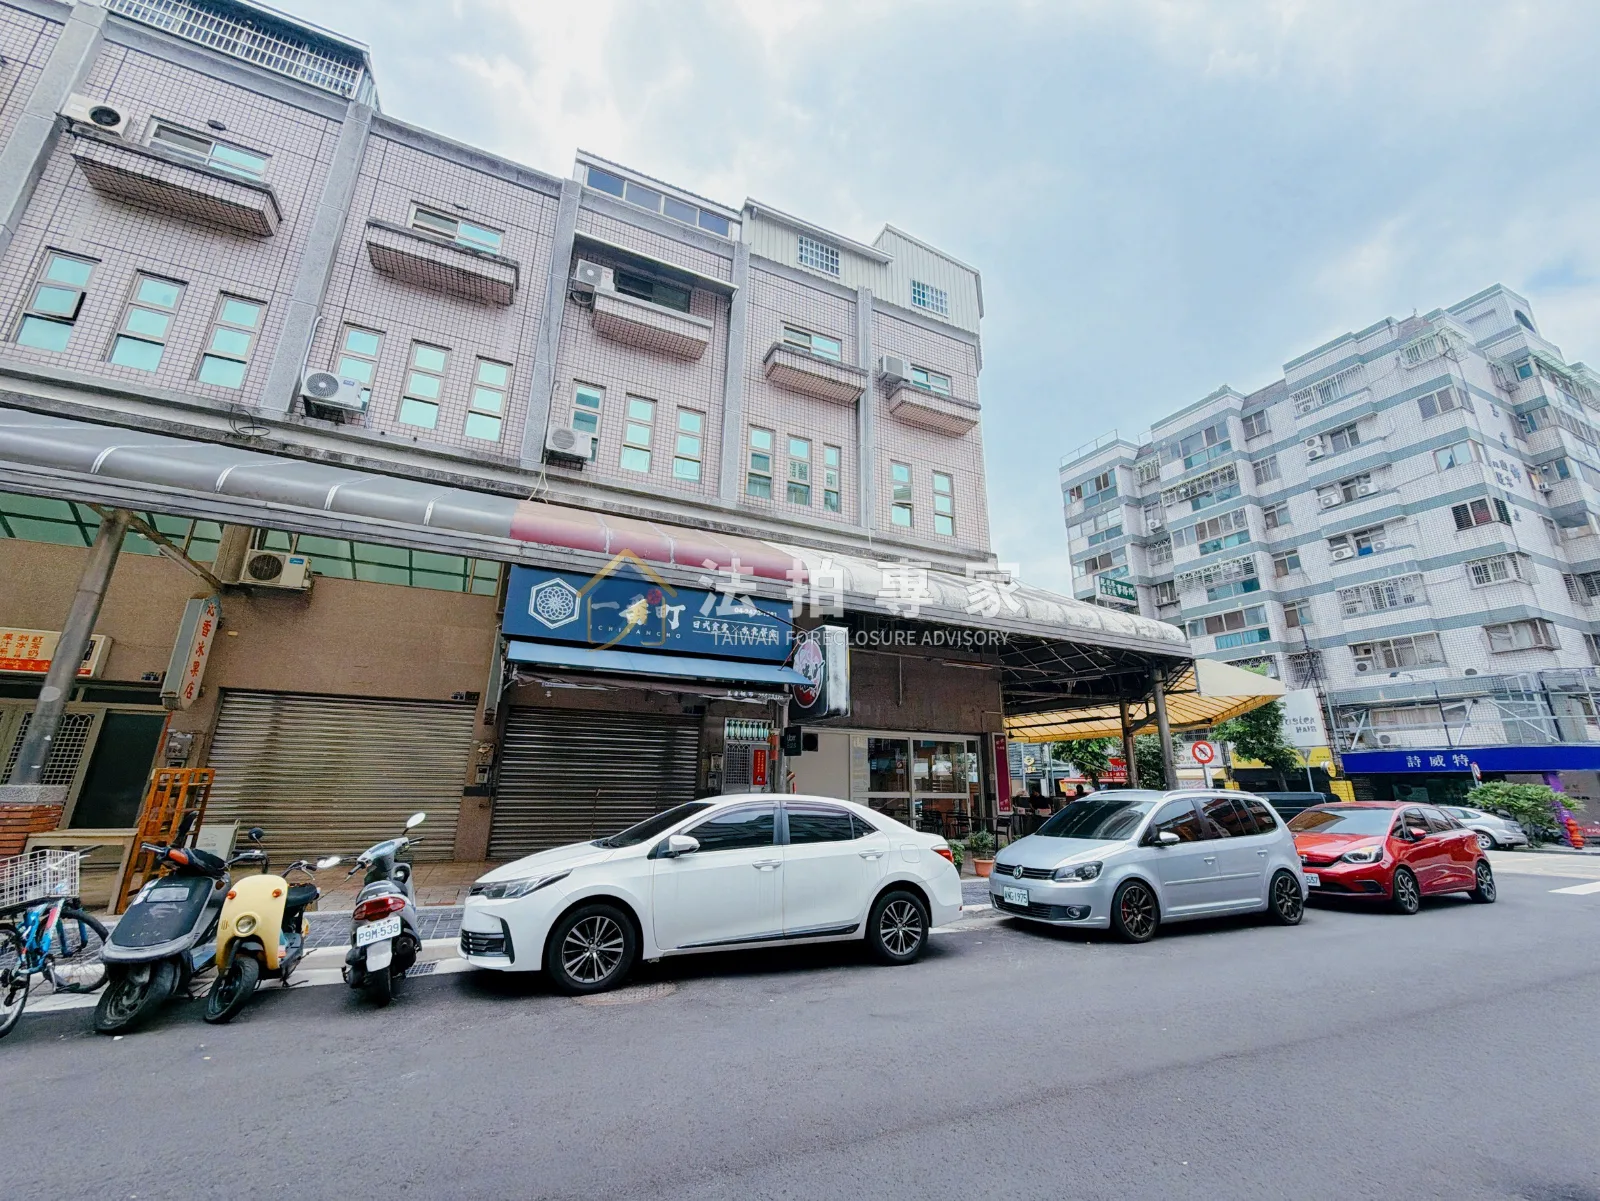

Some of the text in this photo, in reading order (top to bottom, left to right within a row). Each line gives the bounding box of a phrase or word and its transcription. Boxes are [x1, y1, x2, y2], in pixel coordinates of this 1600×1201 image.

[591, 593, 687, 630] 一番町
[1406, 753, 1469, 768] 詩威特
[358, 922, 400, 944] P9M-539
